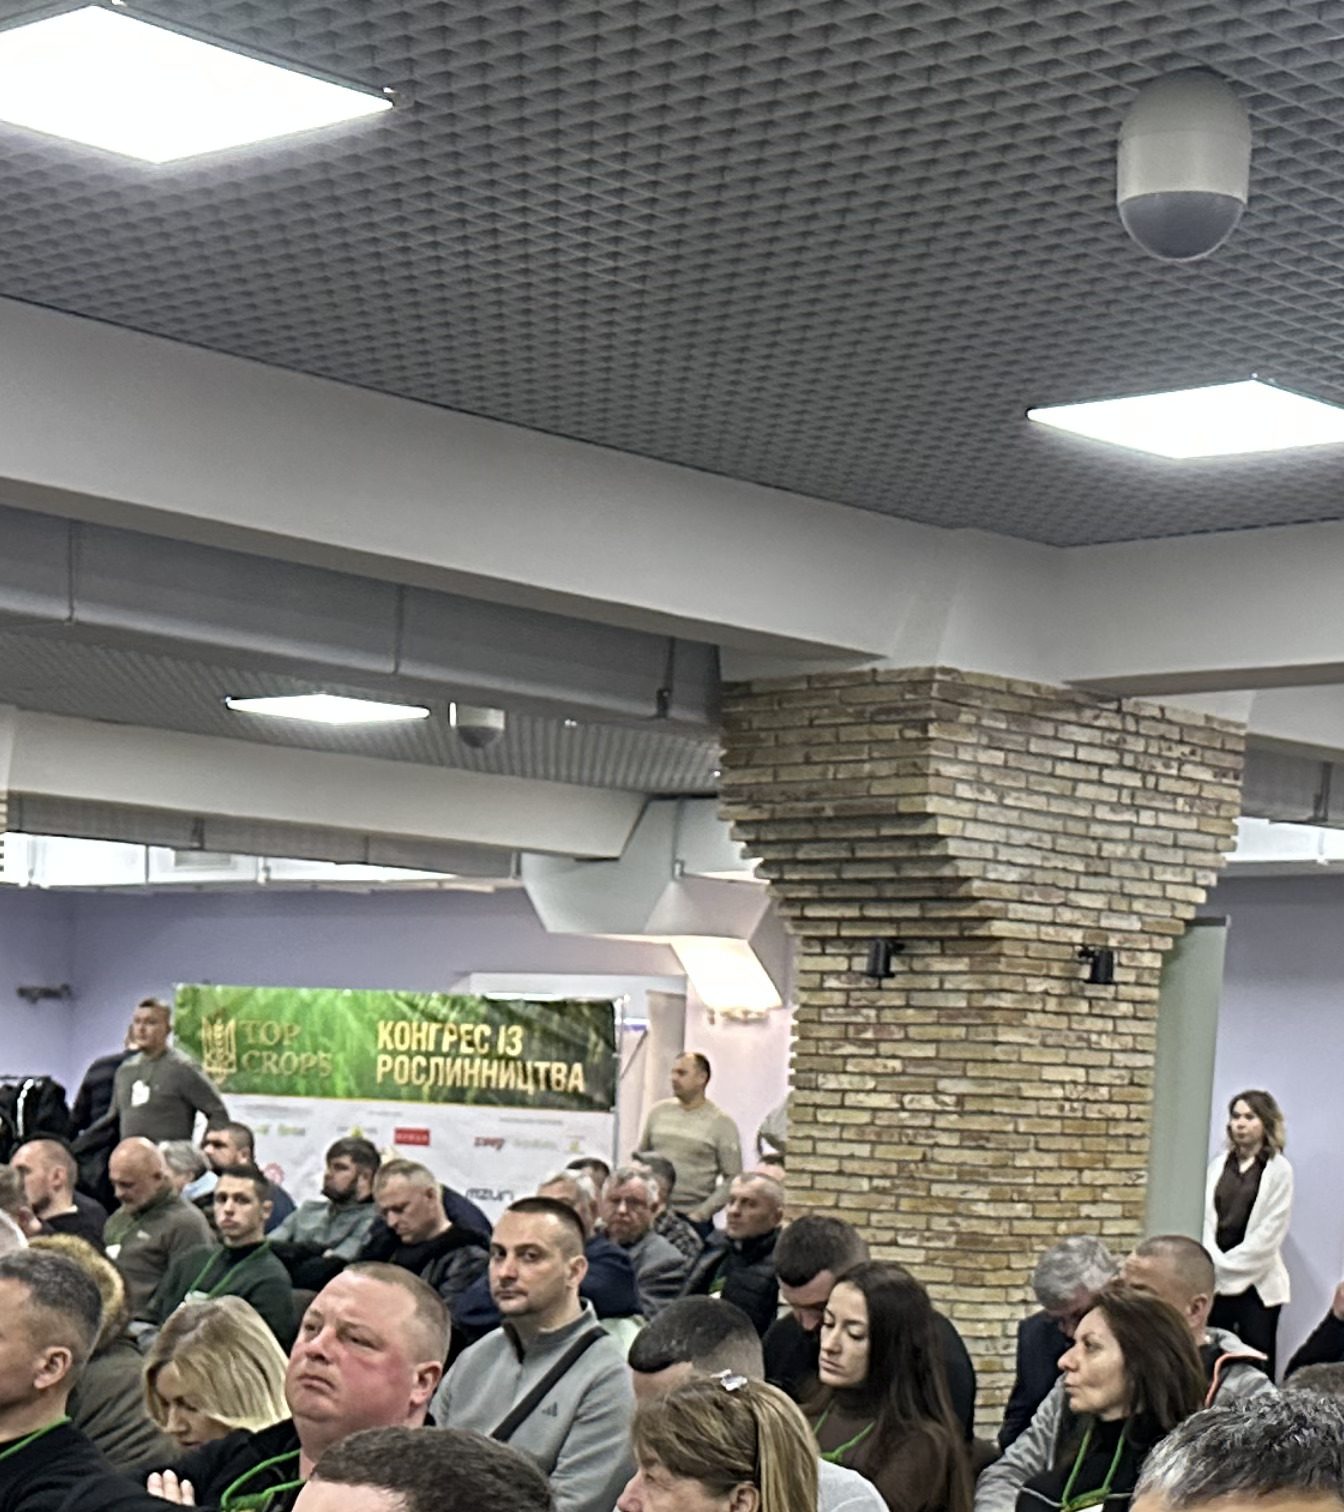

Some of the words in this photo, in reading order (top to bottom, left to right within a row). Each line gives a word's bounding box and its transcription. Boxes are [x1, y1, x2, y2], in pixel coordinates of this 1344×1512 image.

[241, 1020, 300, 1046] TOP
[377, 1020, 495, 1056] КОНГРЕС
[497, 1025, 523, 1057] ІЗ
[241, 1050, 333, 1078] CROPS
[376, 1055, 586, 1094] РОСЛИННИЦТВА
